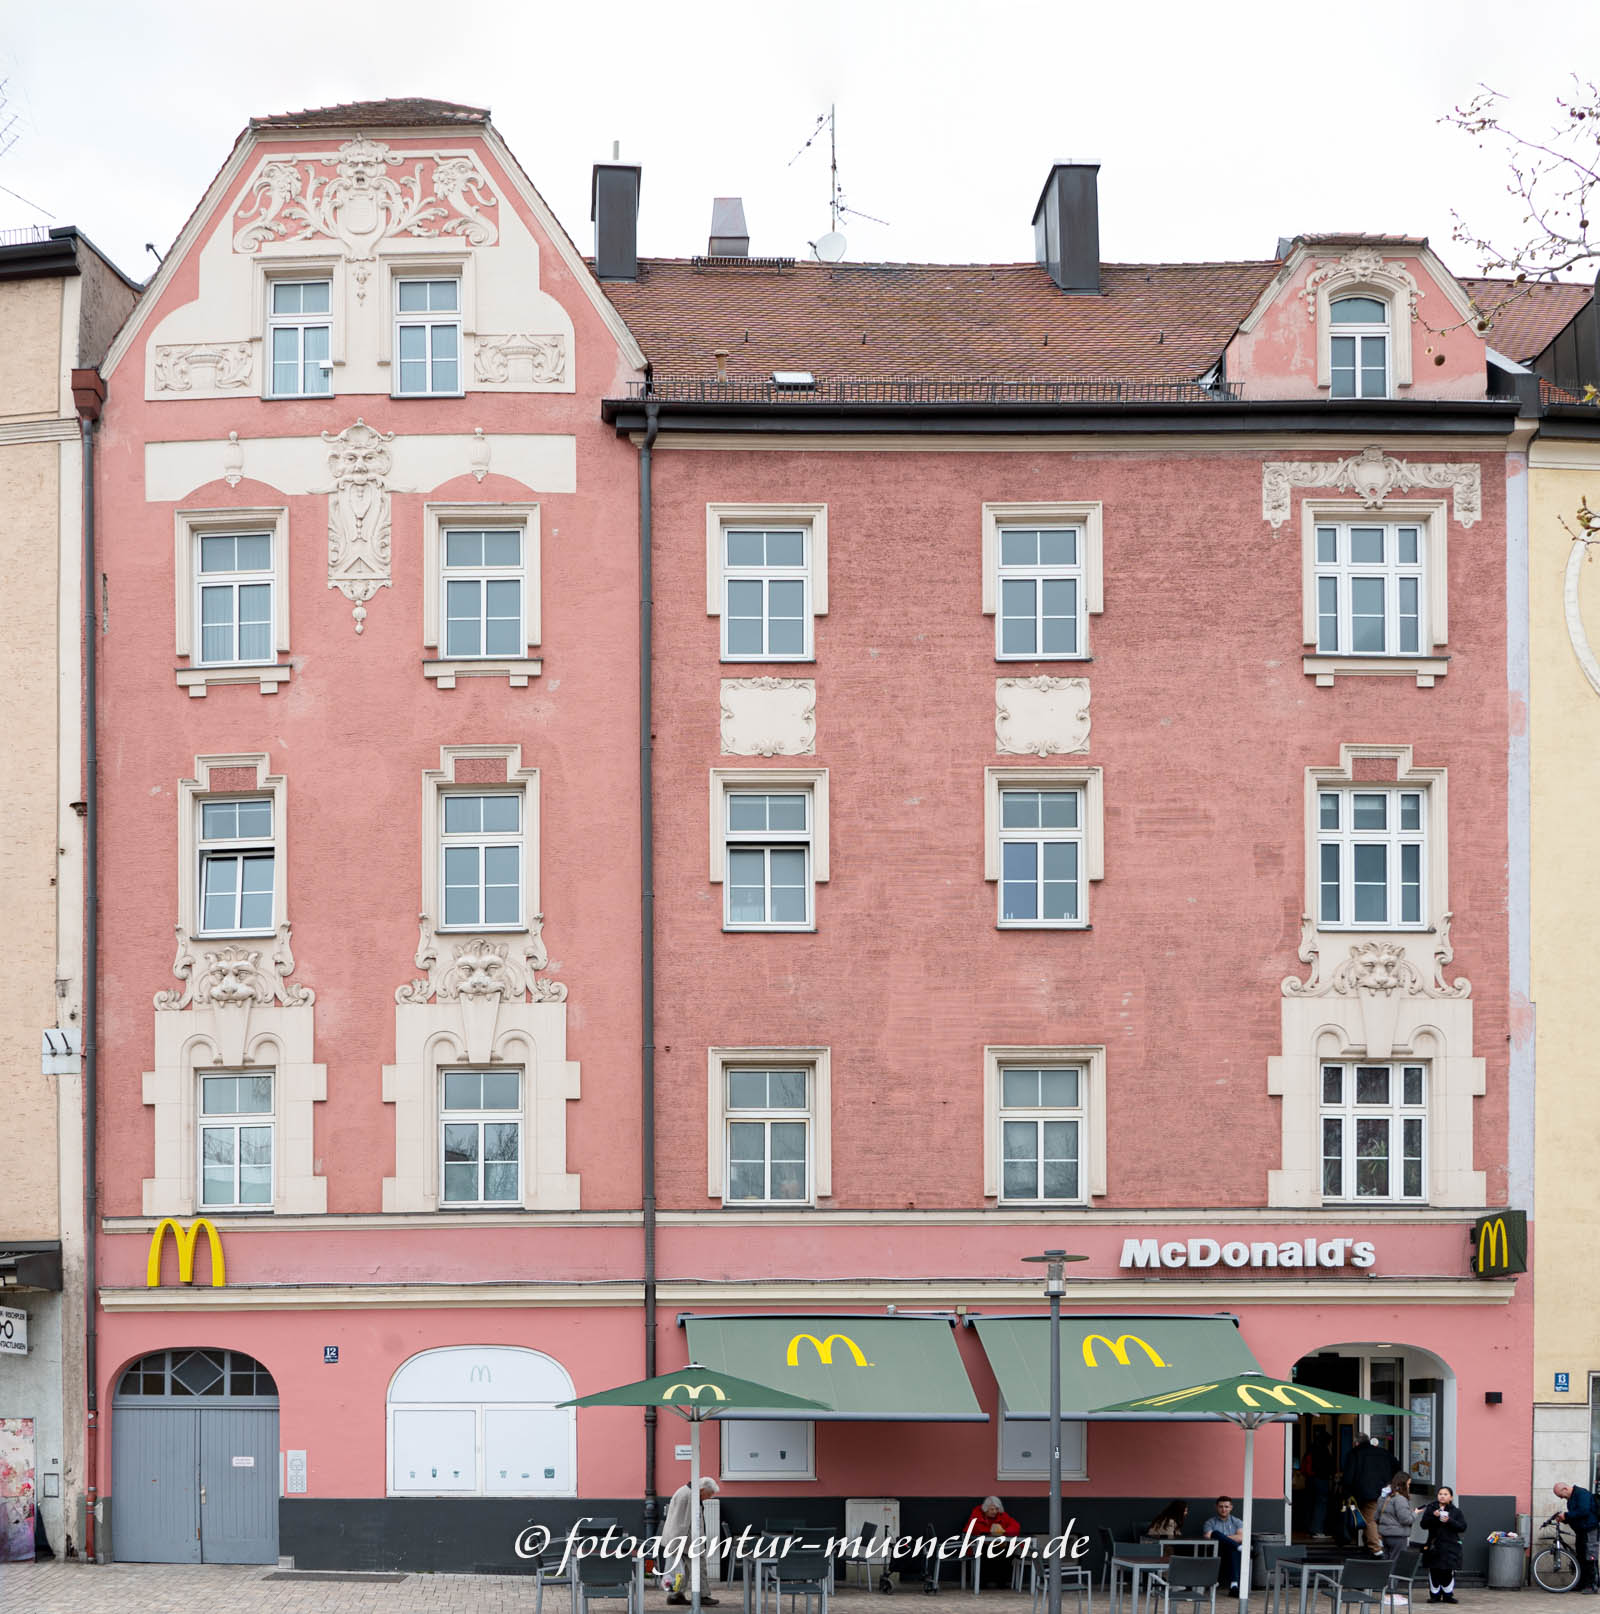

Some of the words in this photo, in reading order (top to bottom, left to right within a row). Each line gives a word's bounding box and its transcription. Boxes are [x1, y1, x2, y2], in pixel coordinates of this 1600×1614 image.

[1119, 1238, 1376, 1268] McDonald's
[326, 1347, 337, 1356] 12
[1558, 1374, 1566, 1384] 13
